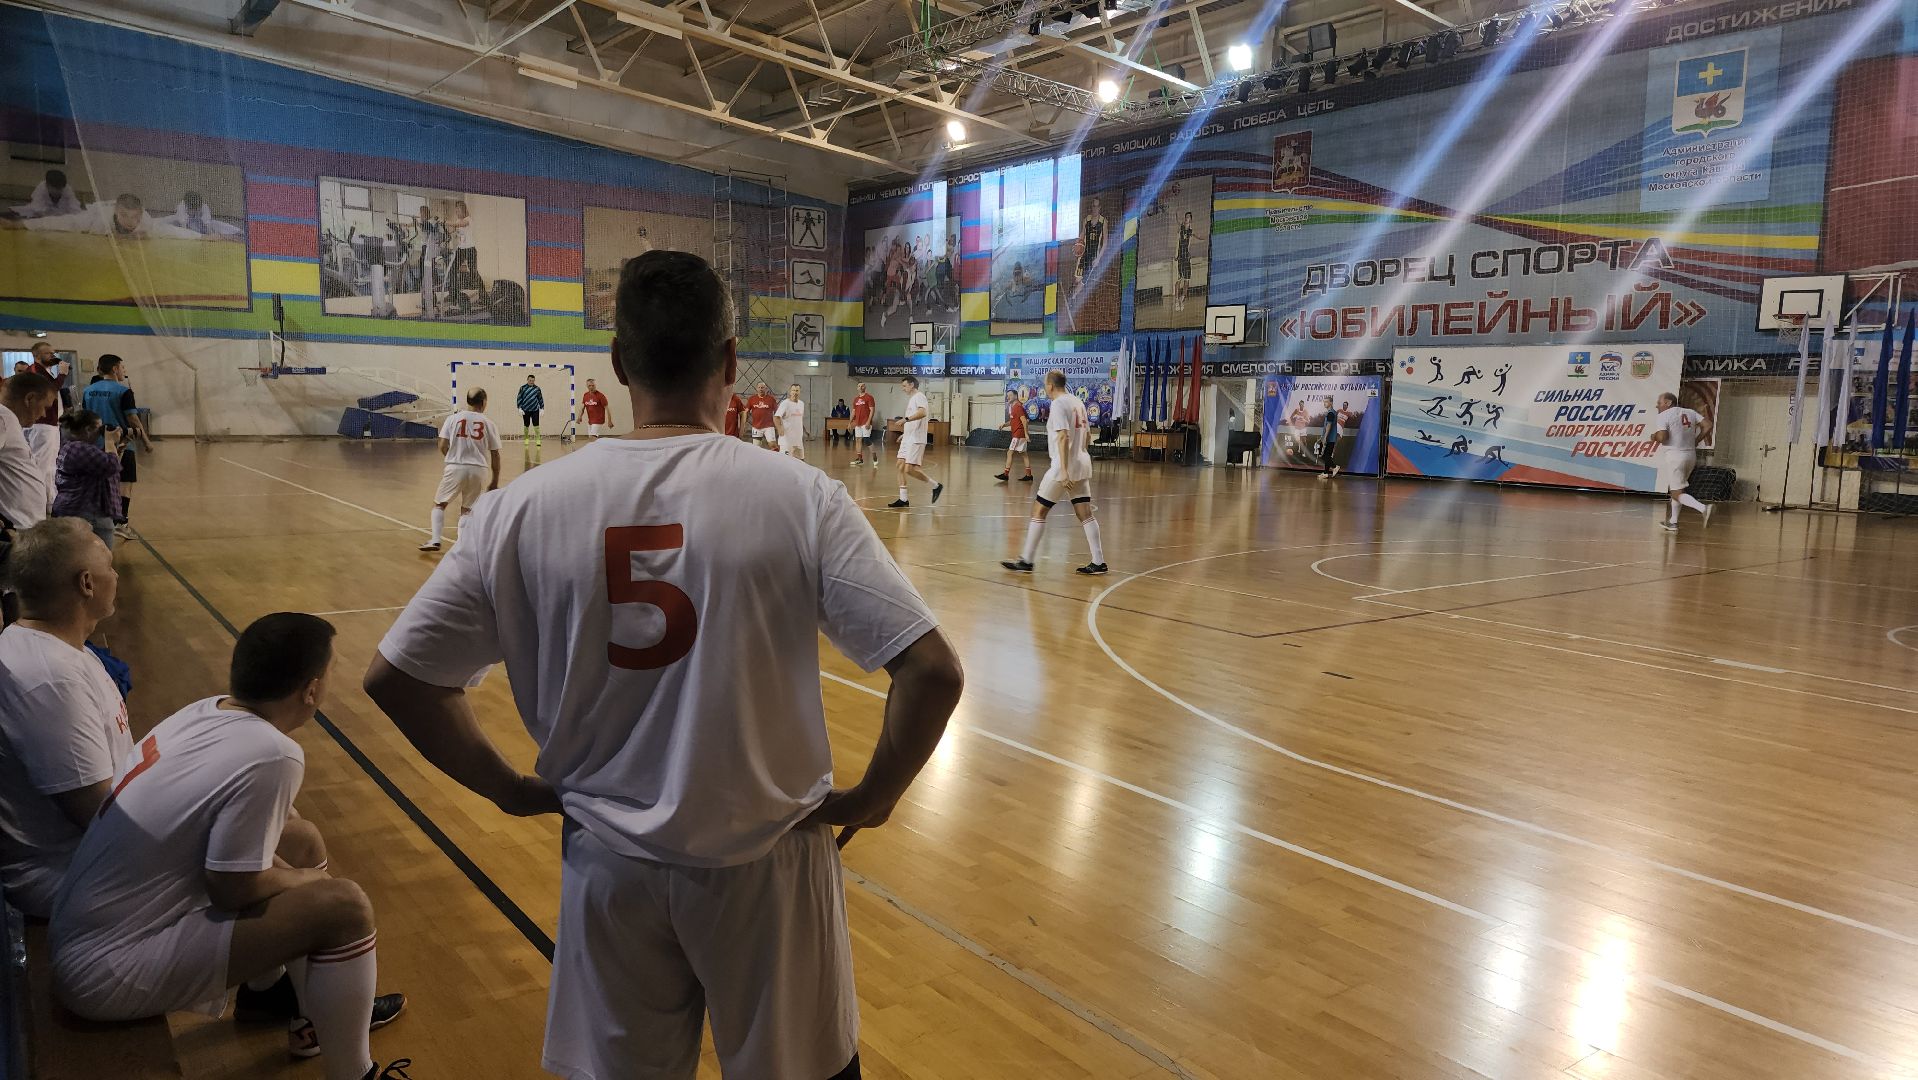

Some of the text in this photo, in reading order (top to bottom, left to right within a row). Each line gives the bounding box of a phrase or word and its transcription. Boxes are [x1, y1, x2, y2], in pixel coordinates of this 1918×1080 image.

[880, 185, 914, 198] ЧЕМПИОН
[918, 181, 946, 193] ПОЛ
[1112, 136, 1160, 153] ЭМОЦИИ
[1169, 123, 1225, 142] РАДОСТЬ
[1233, 108, 1287, 130] ПОБЕДА
[1296, 99, 1336, 117] ЦЕЛЬ
[1714, 172, 1761, 185] ласти
[1301, 237, 1676, 297] ДВОРЕЦ СПОРТА
[1278, 281, 1708, 341] «ЮБИЛЕЙНЫЙ»
[855, 366, 879, 375] МЕЧТА
[883, 366, 918, 375] ЗДОРОВЬЕ
[921, 366, 945, 375] УСПЕХ
[950, 366, 986, 375] ЭНЕРГИЯ
[1067, 366, 1099, 375] ФУТБОЛА
[1221, 362, 1293, 375] СМЕЛОСТЬ
[1303, 361, 1361, 376] РЕКОРД
[1534, 388, 1604, 403] СИЛЬНАЯ
[1554, 404, 1636, 422] РОССИЯ
[1681, 413, 1692, 428] 4
[456, 418, 485, 441] 13
[1545, 424, 1646, 437] СПОРТИВНАЯ
[1570, 441, 1662, 457] РОССИЯ!
[605, 522, 698, 670] 5
